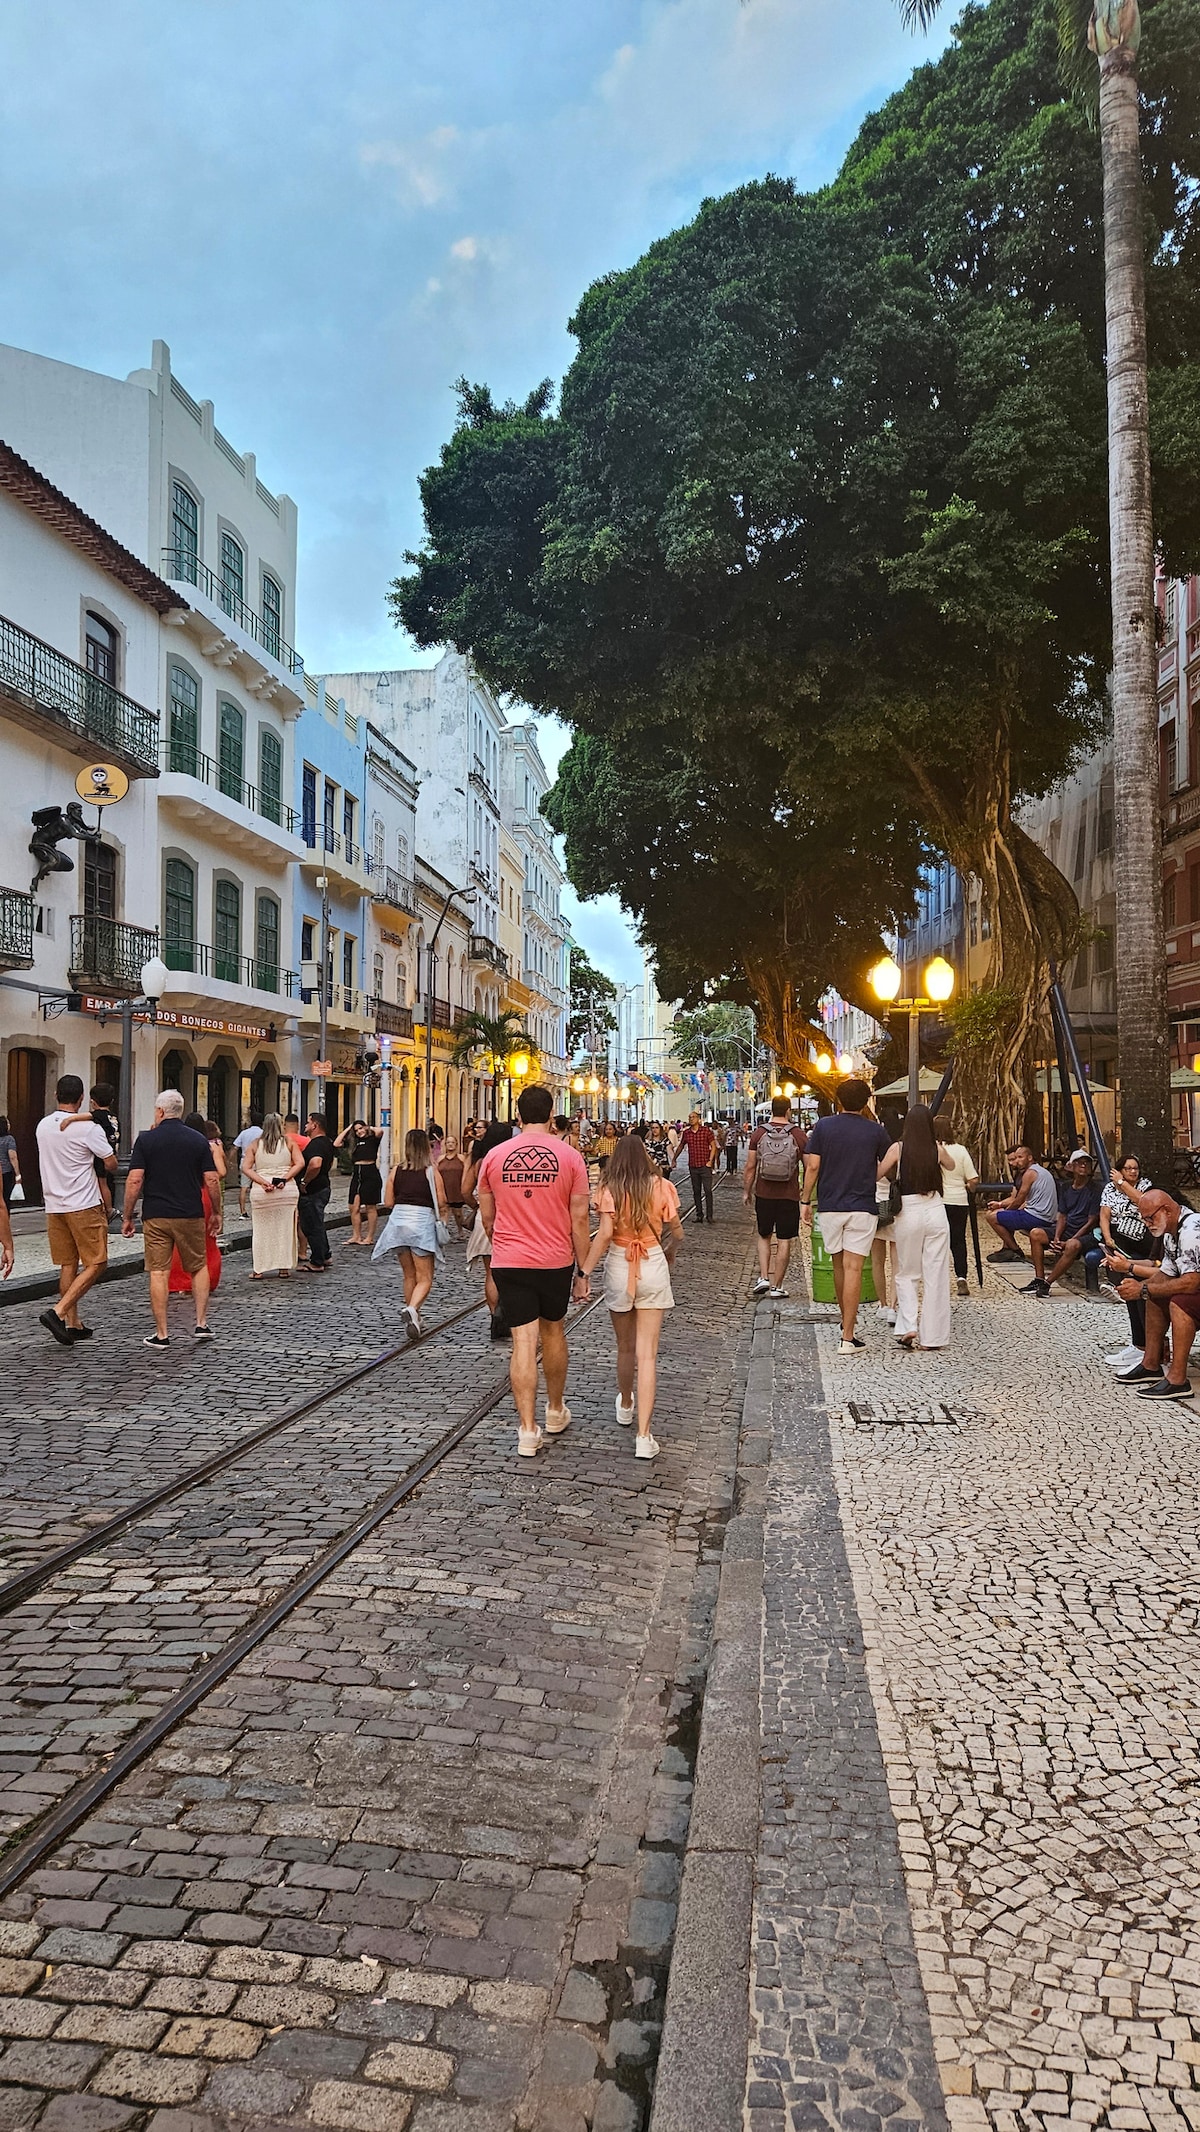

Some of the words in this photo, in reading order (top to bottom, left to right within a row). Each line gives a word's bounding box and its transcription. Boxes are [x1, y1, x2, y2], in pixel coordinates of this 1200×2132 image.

[156, 1011, 177, 1022] DOS
[181, 1015, 224, 1030] BONECOS
[227, 1023, 267, 1037] GIGANTES
[502, 1173, 558, 1183] ELEMENT
